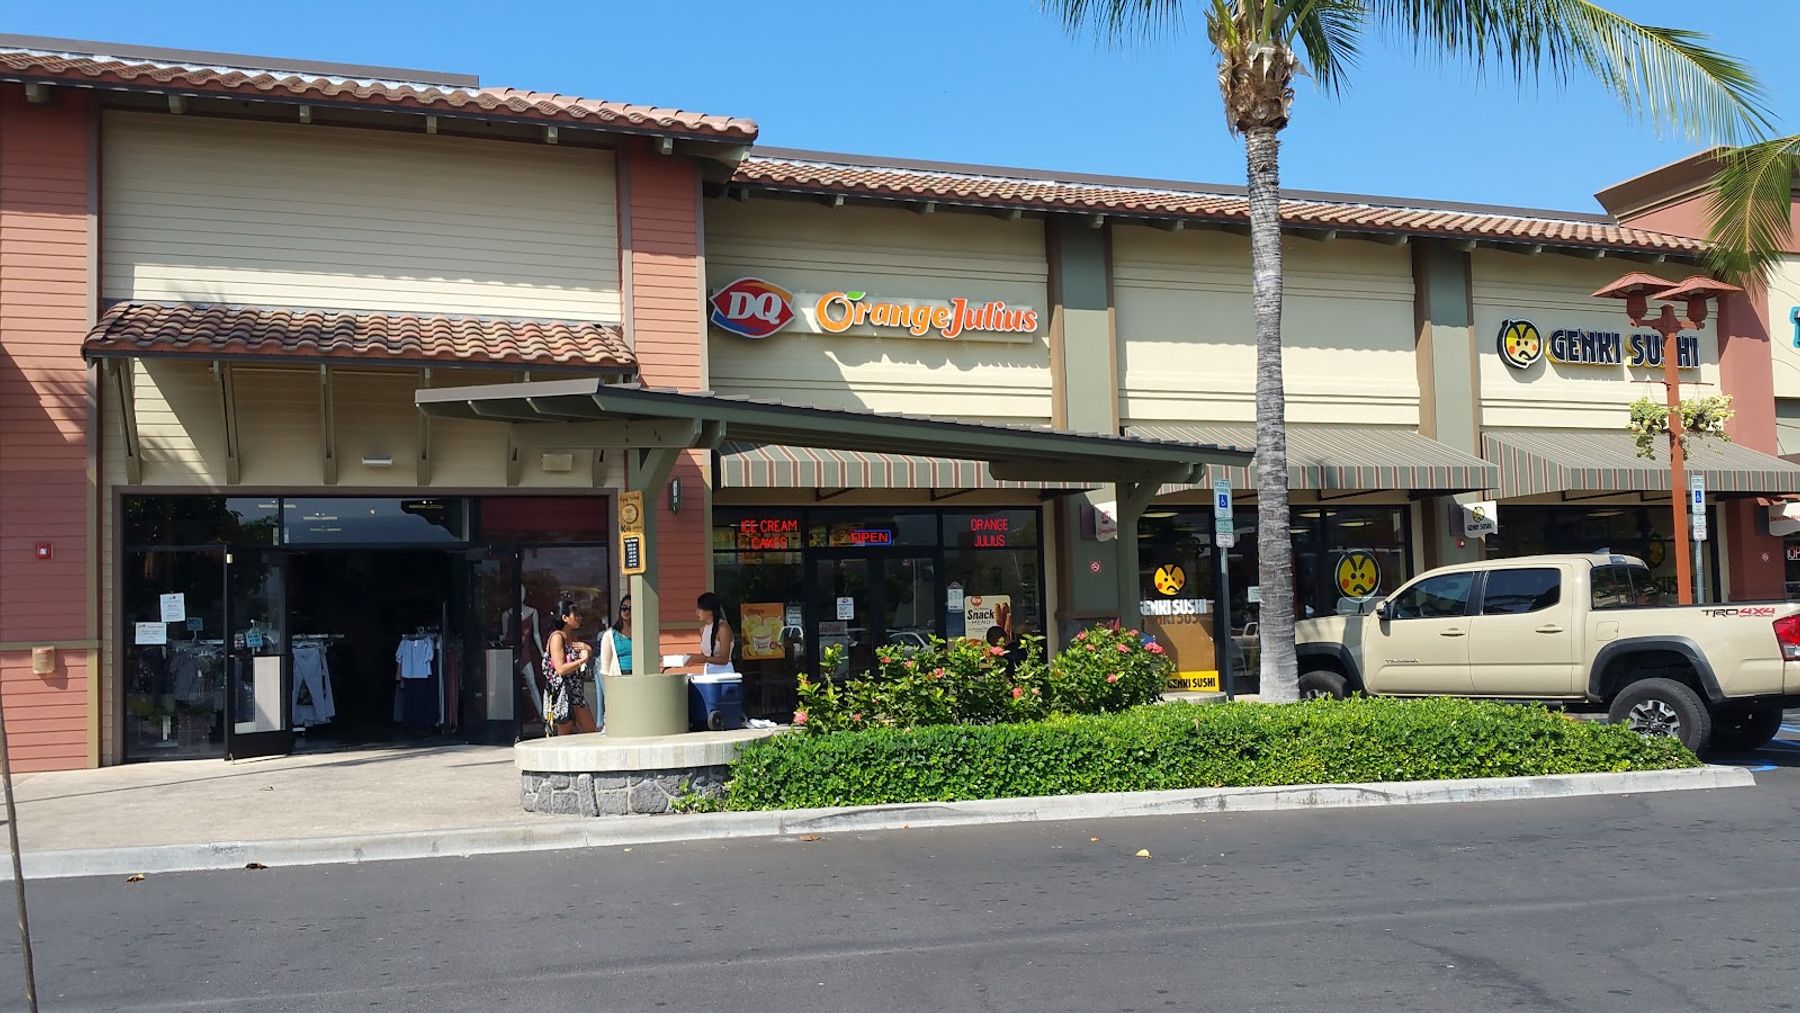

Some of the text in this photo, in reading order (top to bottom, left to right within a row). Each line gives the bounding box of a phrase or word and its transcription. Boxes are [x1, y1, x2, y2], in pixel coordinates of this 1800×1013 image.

[727, 291, 783, 324] DQ
[815, 291, 1038, 339] Orange Julius
[1549, 328, 1700, 369] GENKI SUHI
[739, 519, 798, 533] ICE CREAM
[970, 518, 1009, 532] ORANGE
[974, 534, 1006, 547] JULIUS
[1172, 598, 1207, 615] SUSHI
[967, 609, 995, 620] Snack
[1192, 677, 1216, 688] SUSHI
